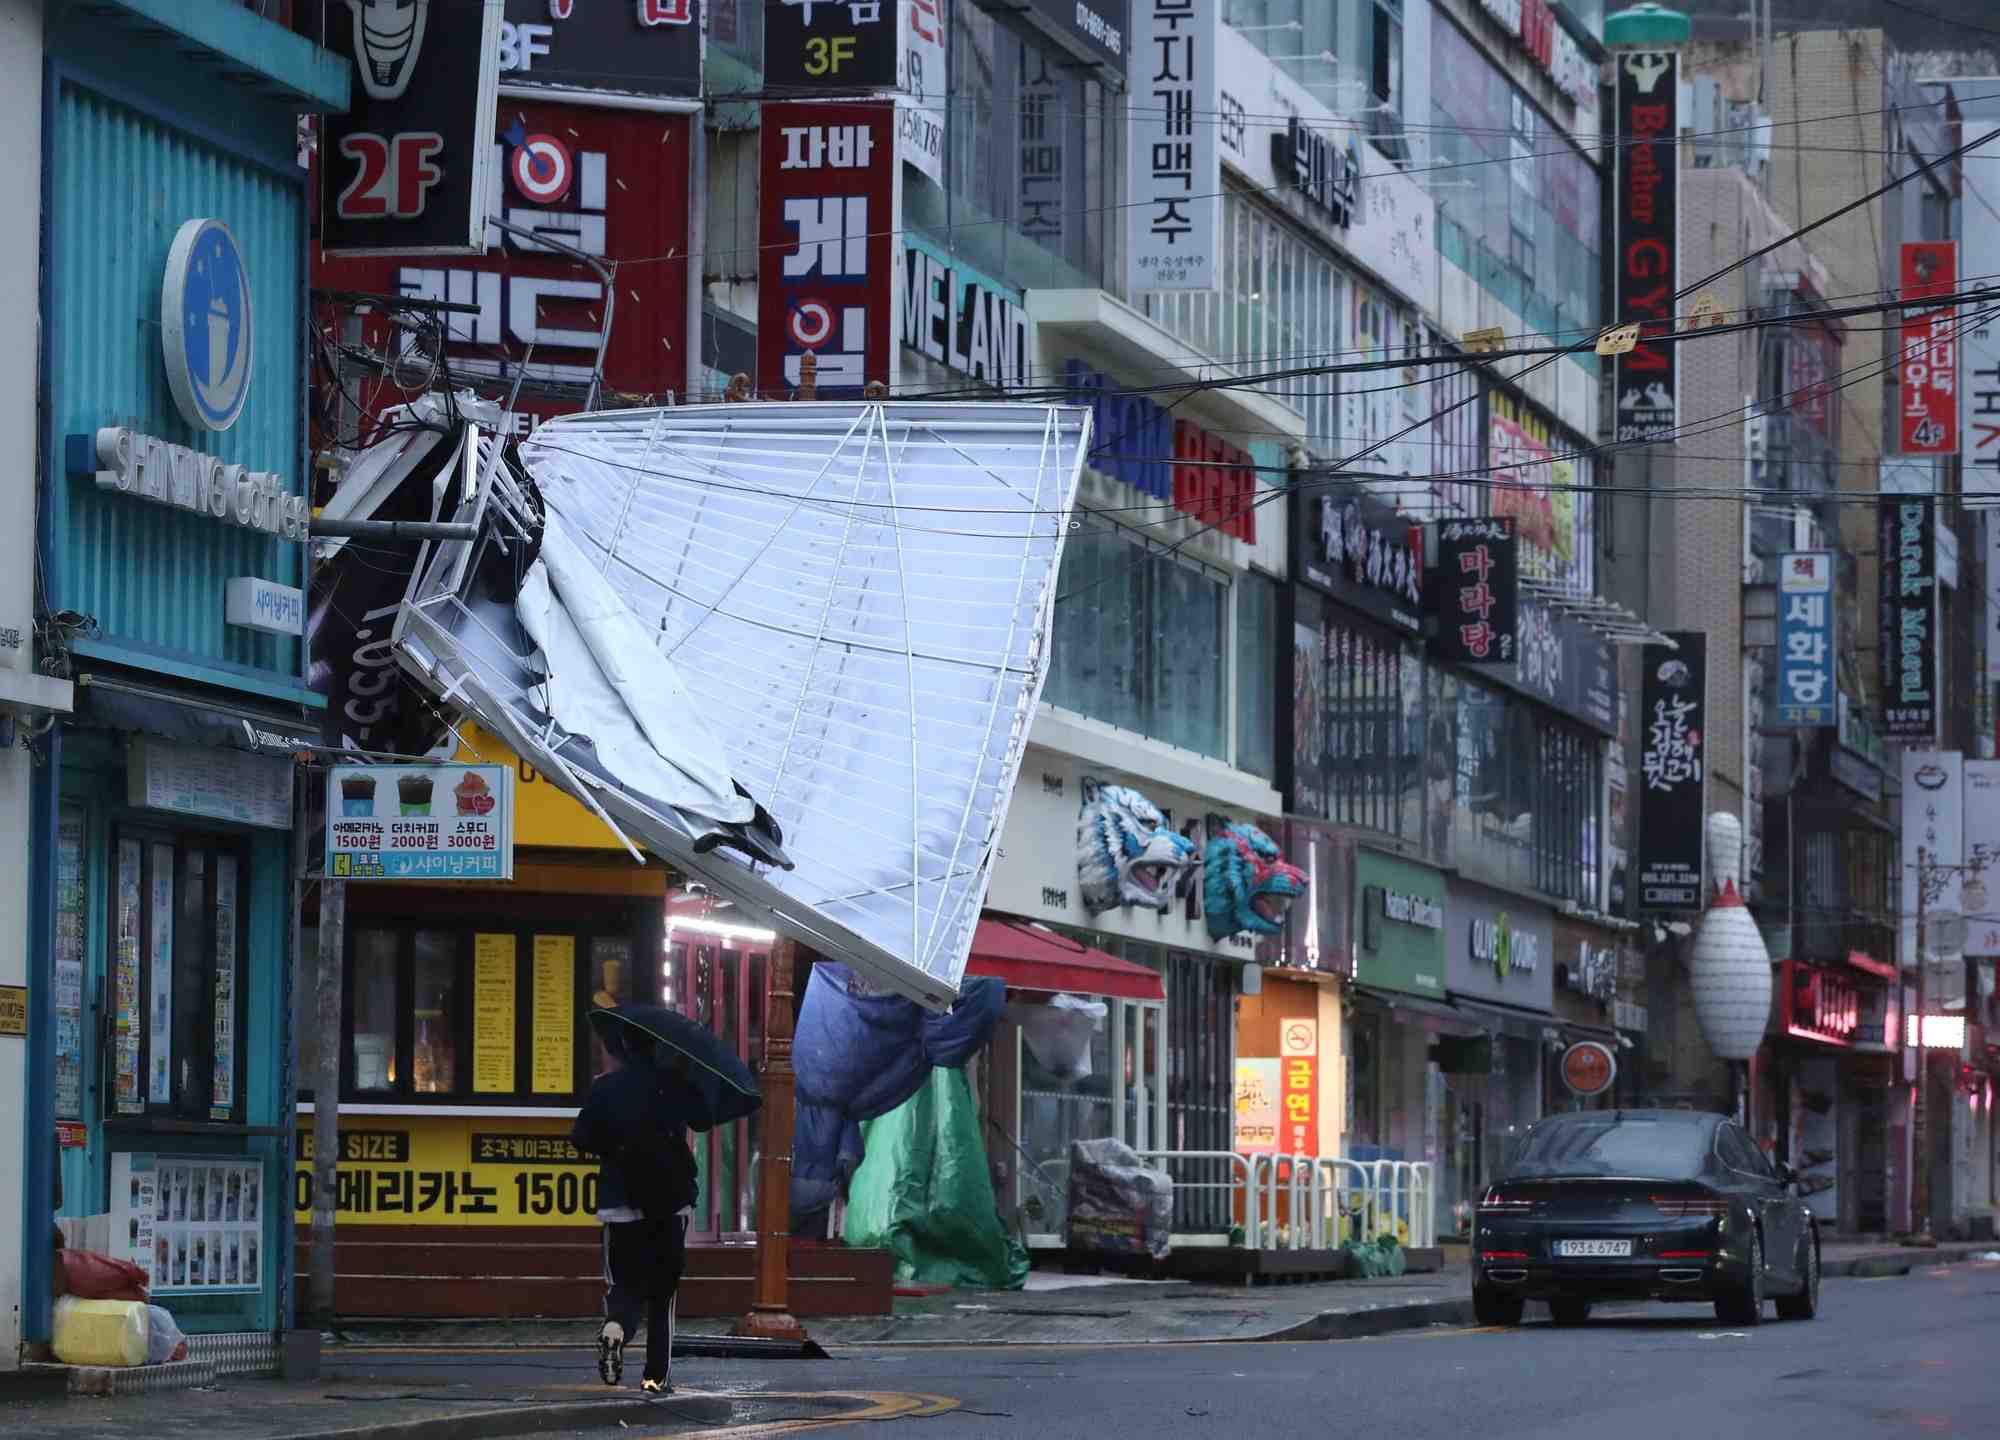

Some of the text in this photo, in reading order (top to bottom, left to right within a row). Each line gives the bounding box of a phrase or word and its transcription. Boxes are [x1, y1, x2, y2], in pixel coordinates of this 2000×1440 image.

[804, 37, 857, 76] 3F
[780, 125, 874, 169] 자바
[1631, 104, 1667, 225] Brother
[338, 132, 443, 221] 2F
[1457, 544, 1496, 659] 마라탕
[333, 821, 488, 834] 아메리카노 더치커피 스무디
[336, 834, 496, 850] 1500원 2000원 3000원
[415, 853, 497, 875] 사이닝커피
[1285, 1060, 1313, 1122] 금연
[347, 1134, 397, 1160] SIZE
[514, 1171, 600, 1215] 1500
